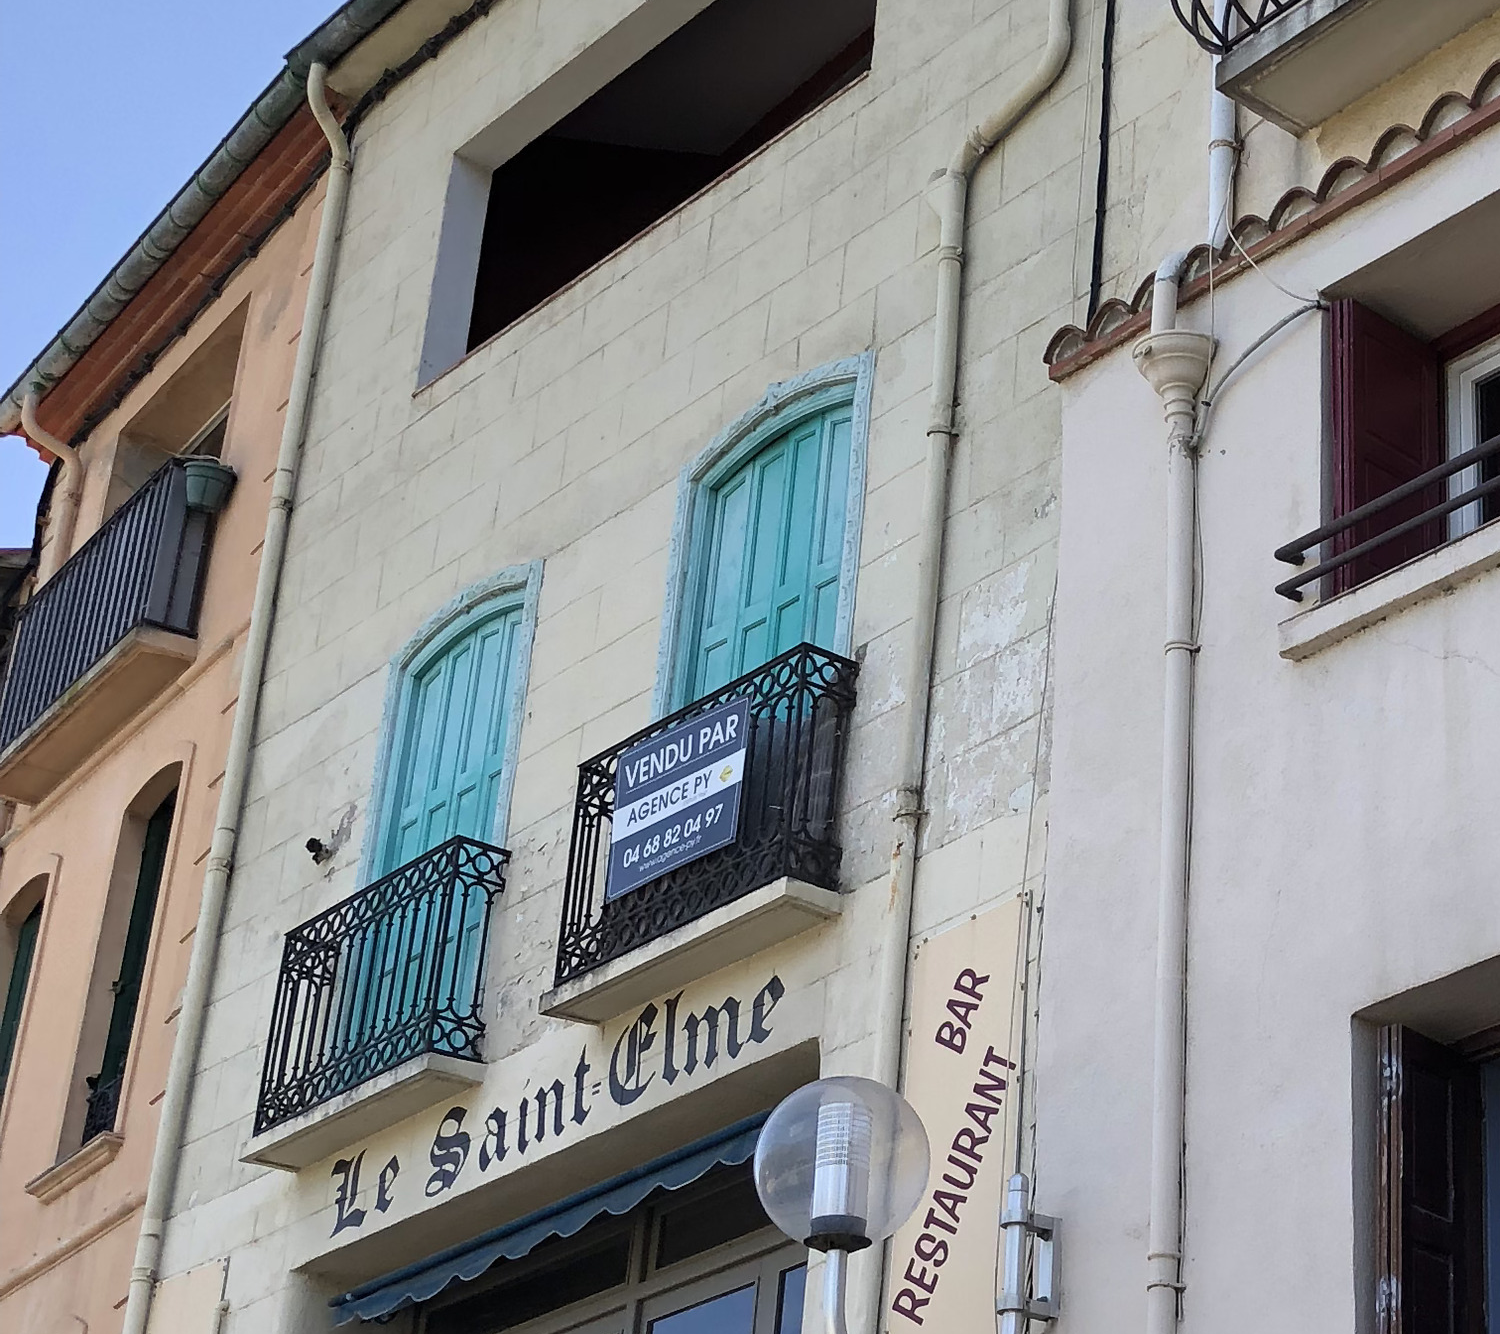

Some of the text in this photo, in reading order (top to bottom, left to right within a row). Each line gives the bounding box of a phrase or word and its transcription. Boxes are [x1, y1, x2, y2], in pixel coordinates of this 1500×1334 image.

[625, 714, 739, 788] VENDU PAR
[623, 803, 724, 868] 04 68 82 04 97
[626, 781, 689, 827] AGENCE
[693, 770, 713, 795] PY
[935, 967, 991, 1055] BAR
[330, 1149, 401, 1238] Le
[892, 1045, 1017, 1327] RESTAURANT
